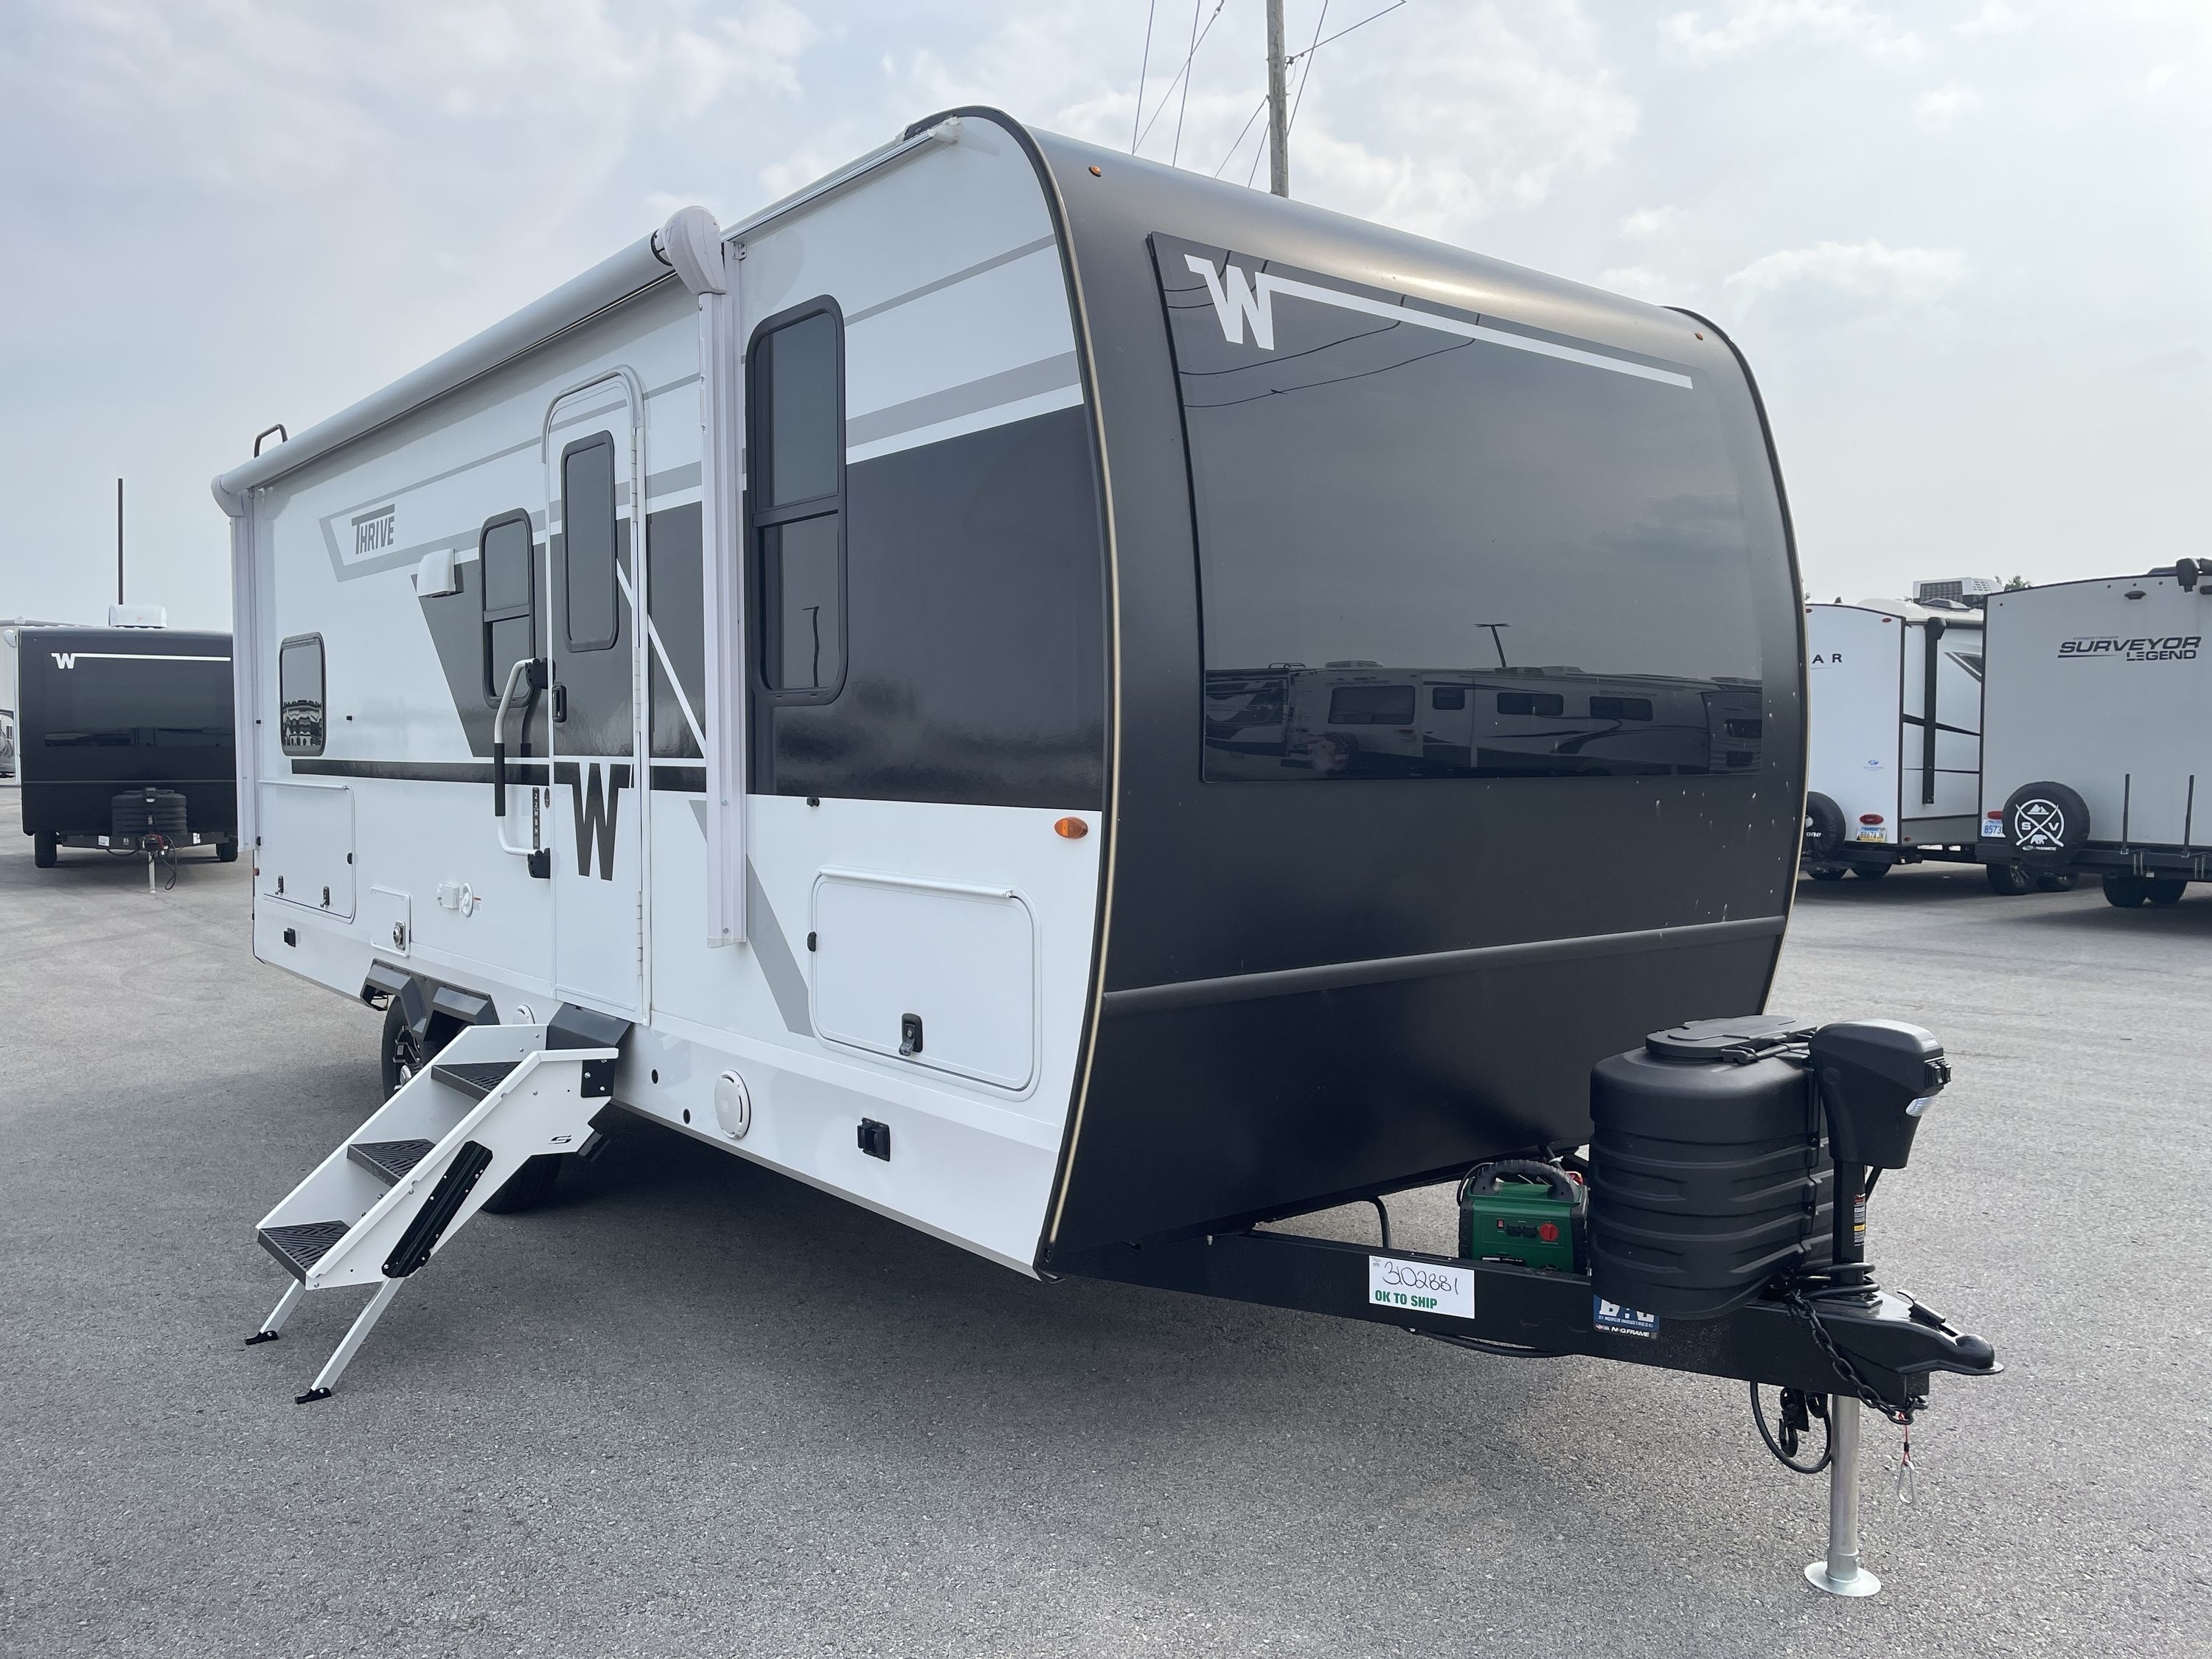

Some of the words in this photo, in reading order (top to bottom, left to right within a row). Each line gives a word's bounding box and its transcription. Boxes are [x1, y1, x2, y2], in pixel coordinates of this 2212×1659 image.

[1184, 254, 1275, 351] W
[352, 503, 395, 555] THRIVE
[2059, 636, 2202, 653] SURVEYOR
[2126, 650, 2197, 661] LEGEND
[51, 653, 76, 669] W
[554, 762, 632, 881] W
[1382, 1262, 1459, 1295] 3102881
[1375, 1290, 1391, 1302] OK
[1394, 1293, 1408, 1305] TO
[1411, 1295, 1438, 1309] SHIP
